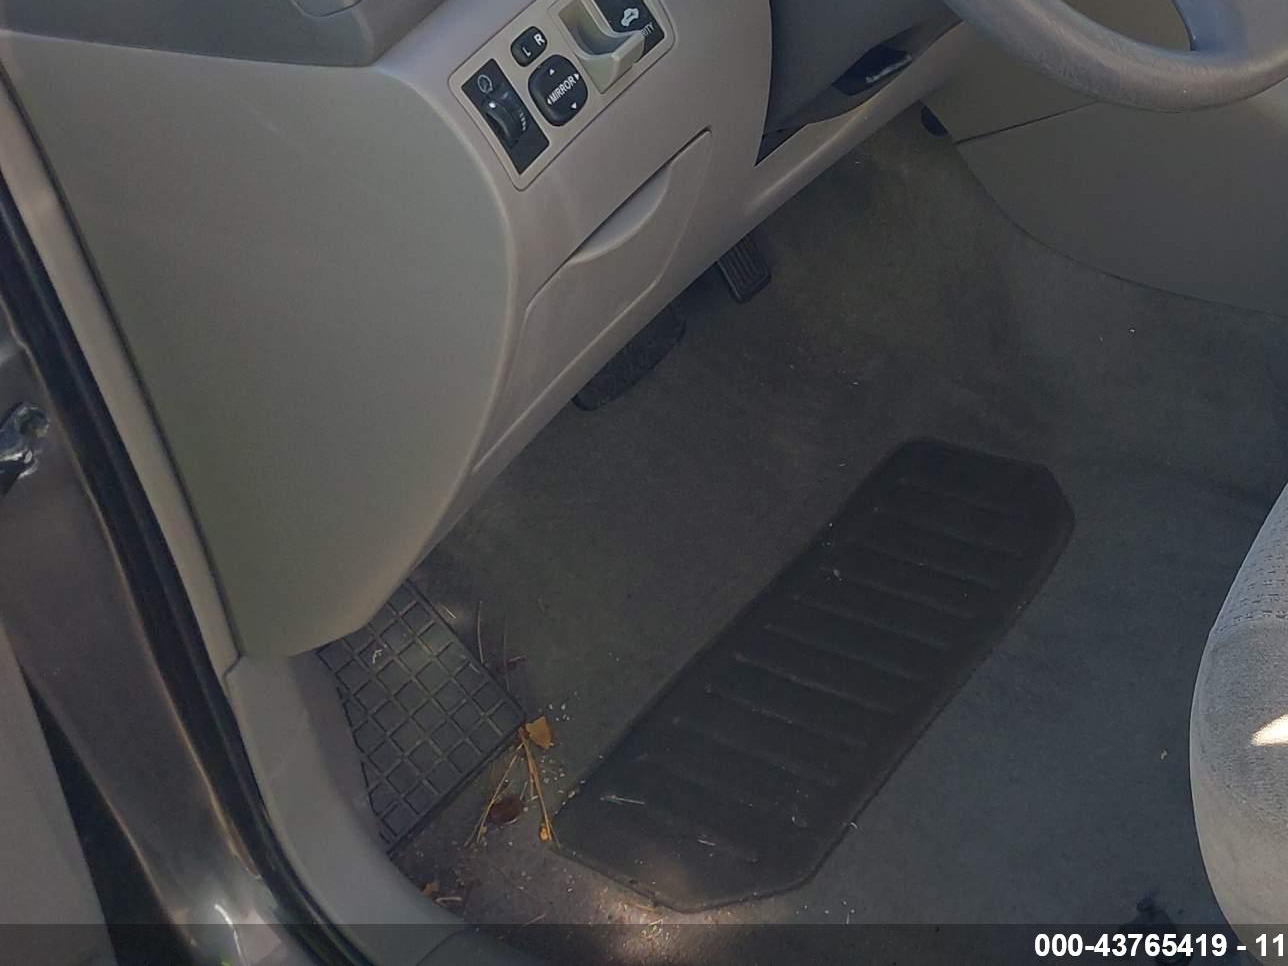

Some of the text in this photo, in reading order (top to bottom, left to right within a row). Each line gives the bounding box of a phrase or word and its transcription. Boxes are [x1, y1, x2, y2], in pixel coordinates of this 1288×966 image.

[533, 33, 545, 46] R
[522, 46, 532, 57] L
[549, 75, 577, 103] MIRROR
